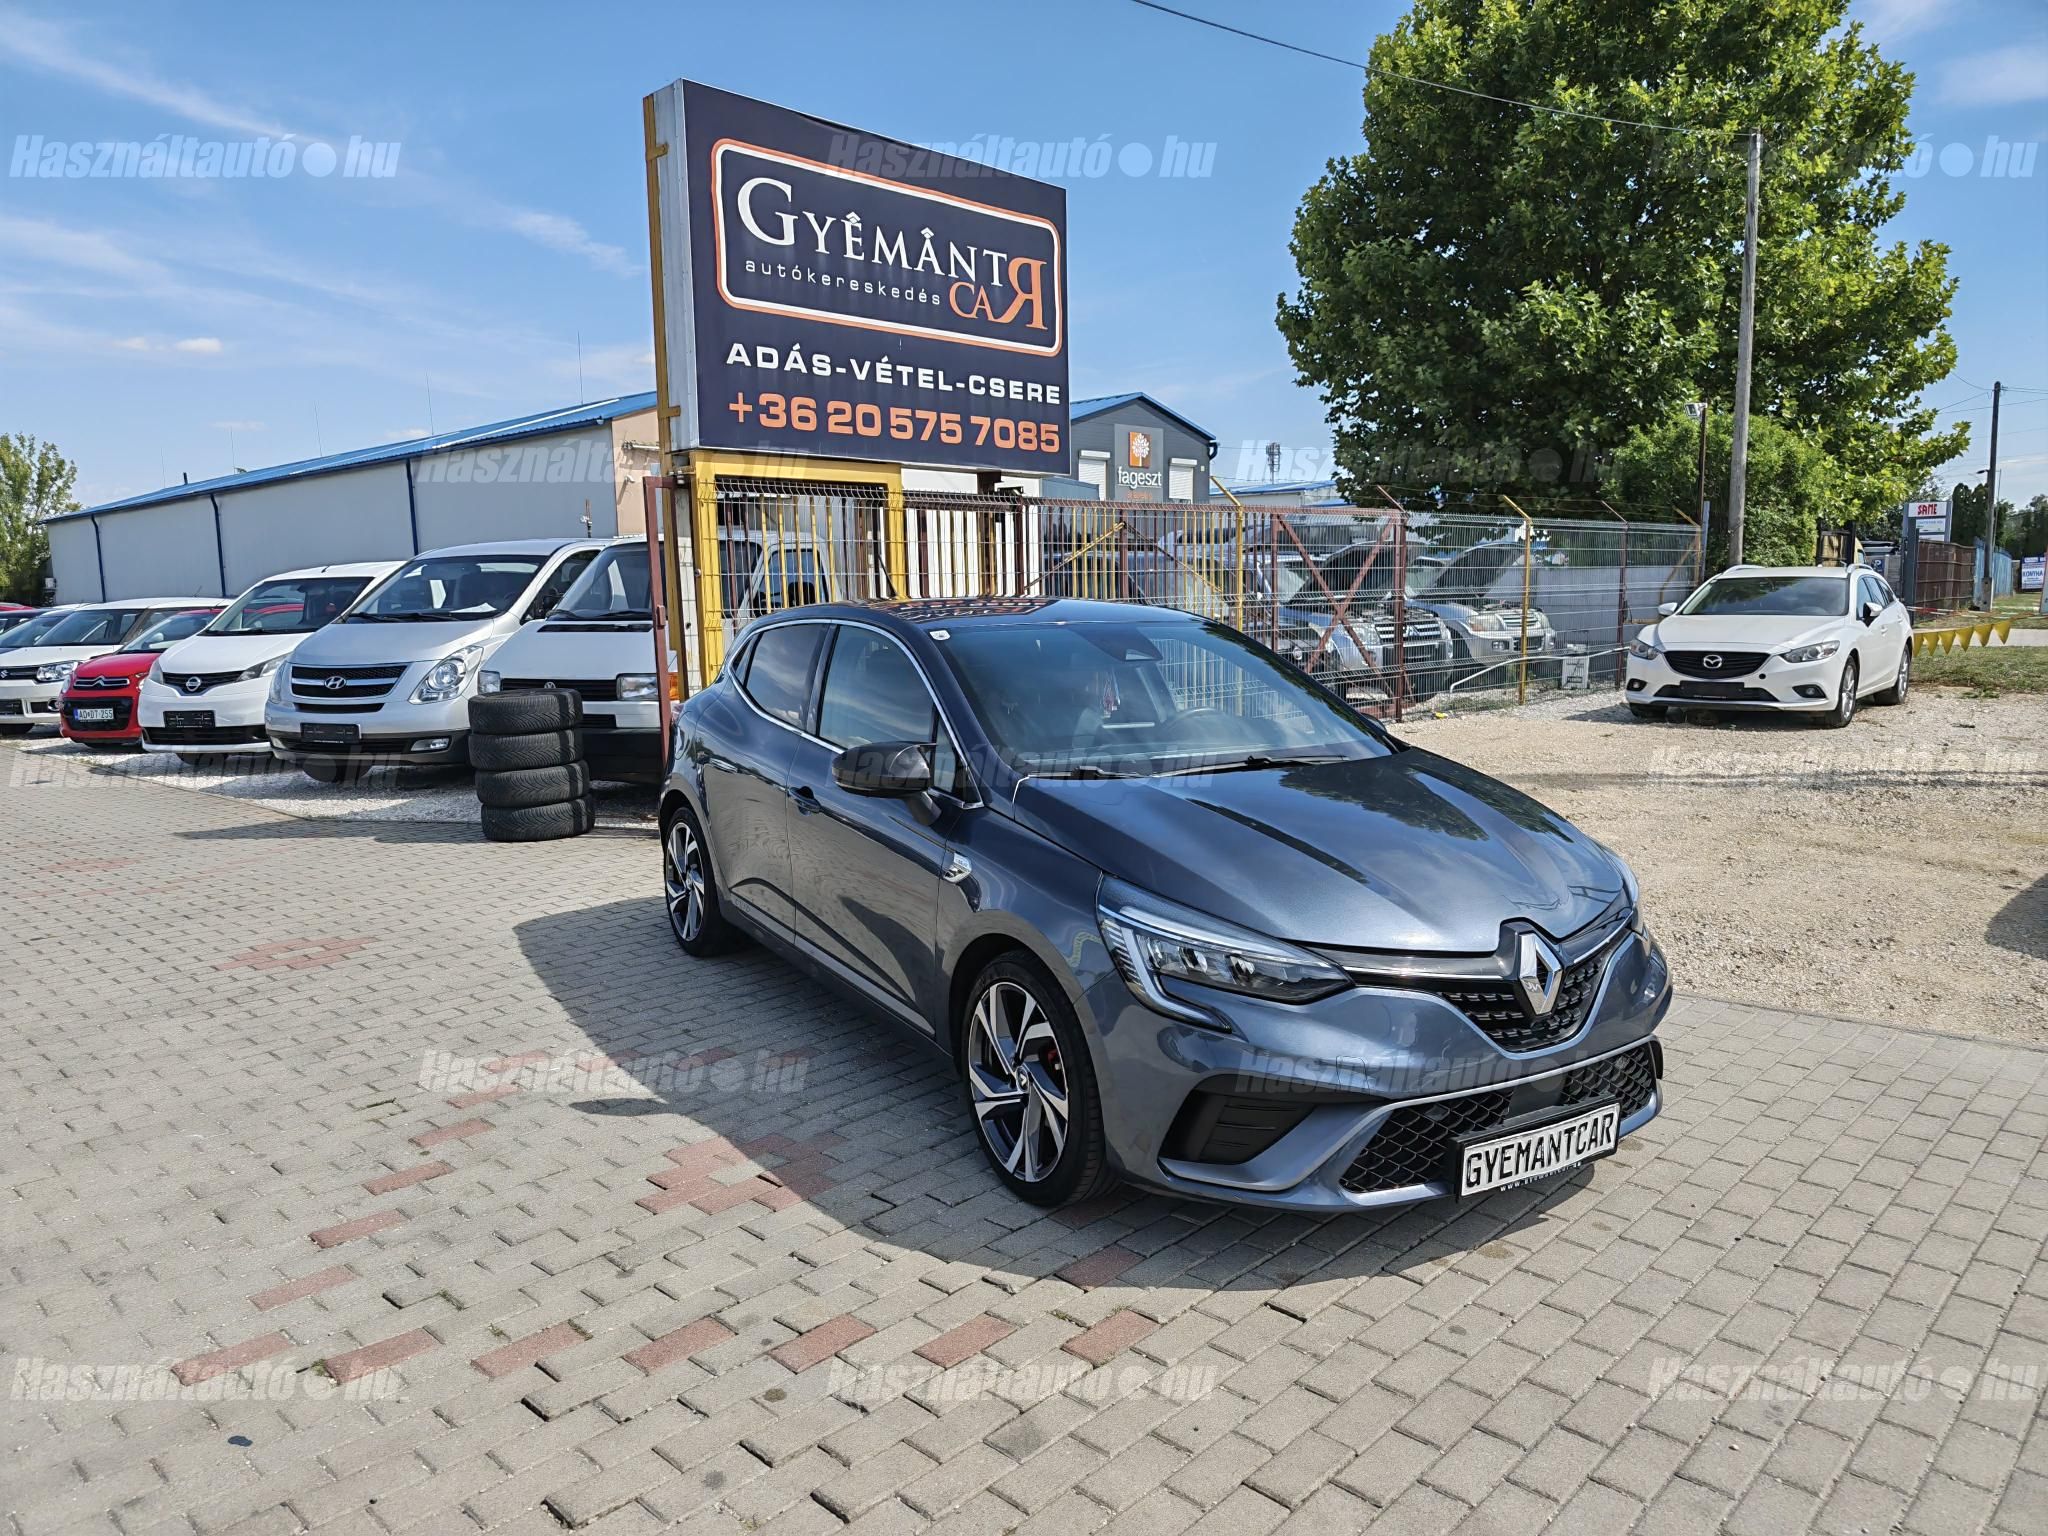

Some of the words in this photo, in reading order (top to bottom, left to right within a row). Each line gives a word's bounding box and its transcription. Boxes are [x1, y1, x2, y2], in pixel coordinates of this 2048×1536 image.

[745, 259, 940, 306] autókereskedés
[726, 342, 1061, 405] ADÁS-VÉTEL-CSERE
[729, 392, 817, 431] +36
[827, 401, 882, 438] 20
[889, 406, 962, 445] 575
[970, 415, 1060, 454] 7085
[1118, 466, 1162, 489] fageszt
[1466, 1113, 1613, 1189] GYEMANTCAR
